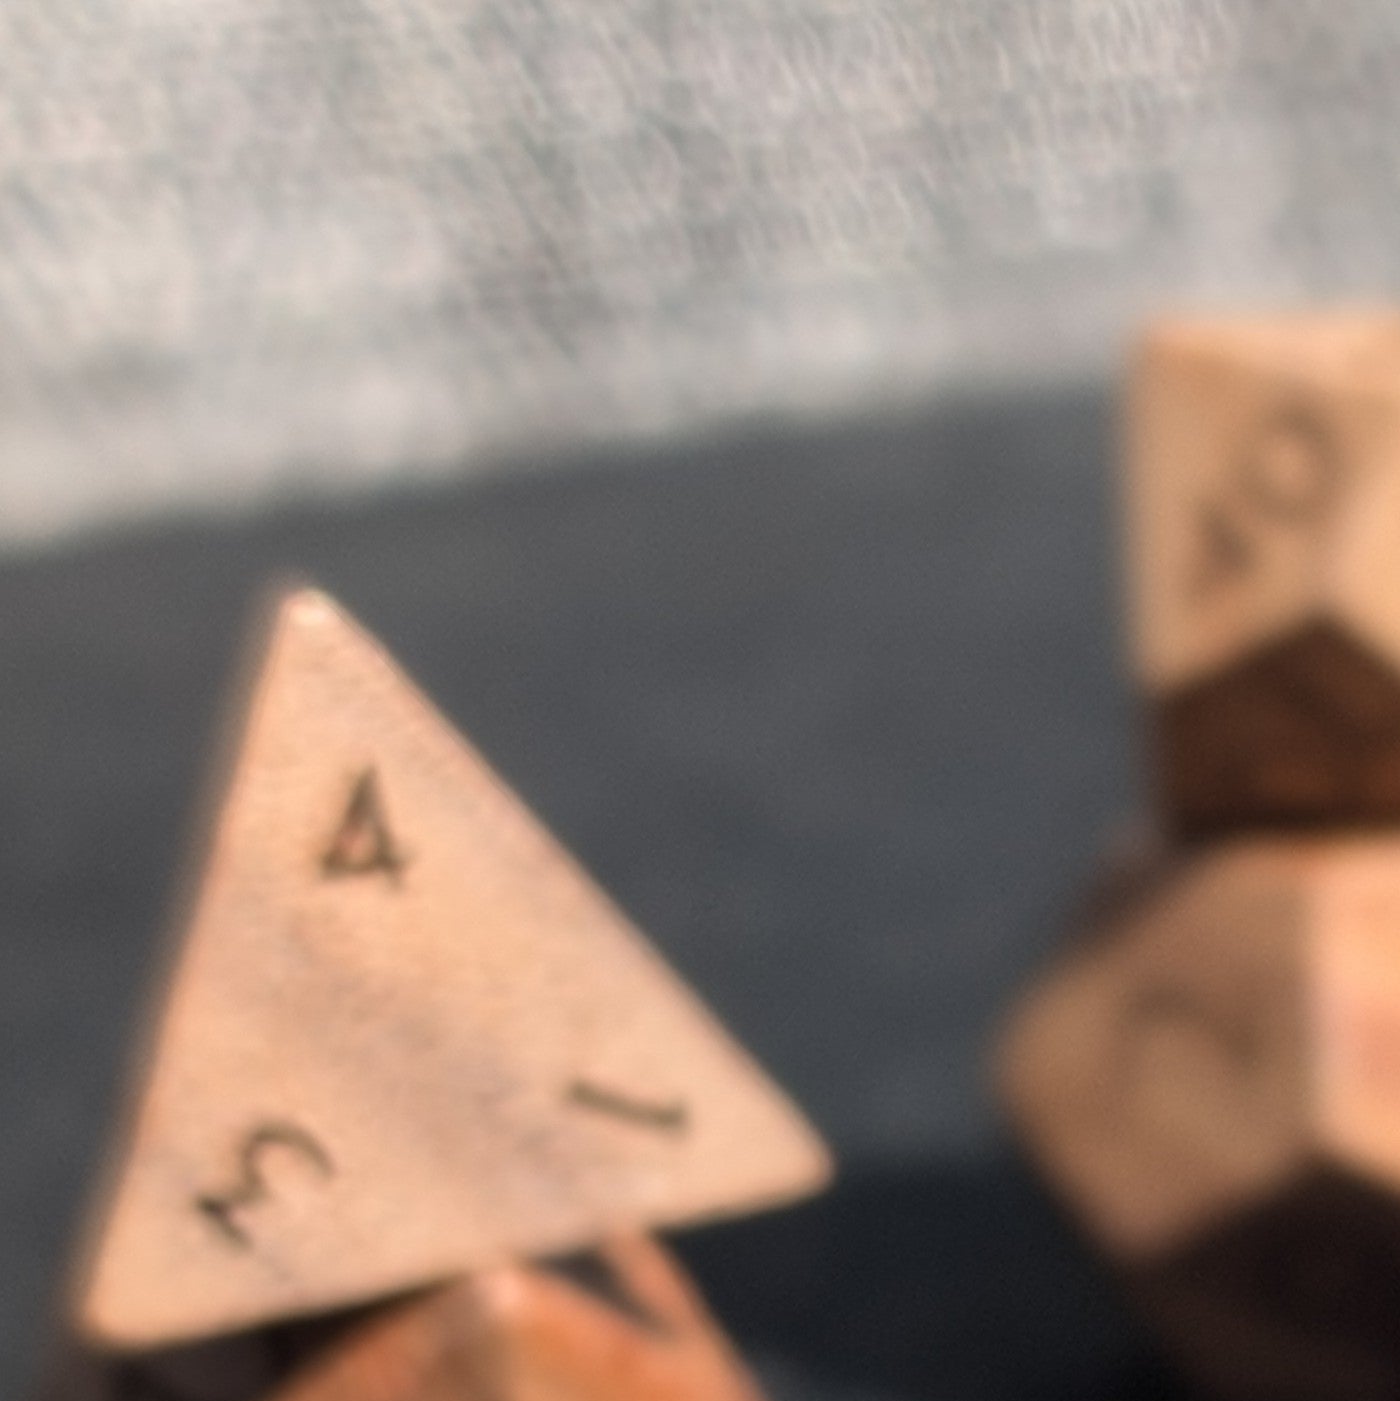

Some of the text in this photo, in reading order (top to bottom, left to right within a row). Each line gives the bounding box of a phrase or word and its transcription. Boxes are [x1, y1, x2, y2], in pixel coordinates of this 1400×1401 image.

[318, 765, 410, 890] 4
[564, 1076, 690, 1134] 1
[193, 1120, 336, 1254] 3
